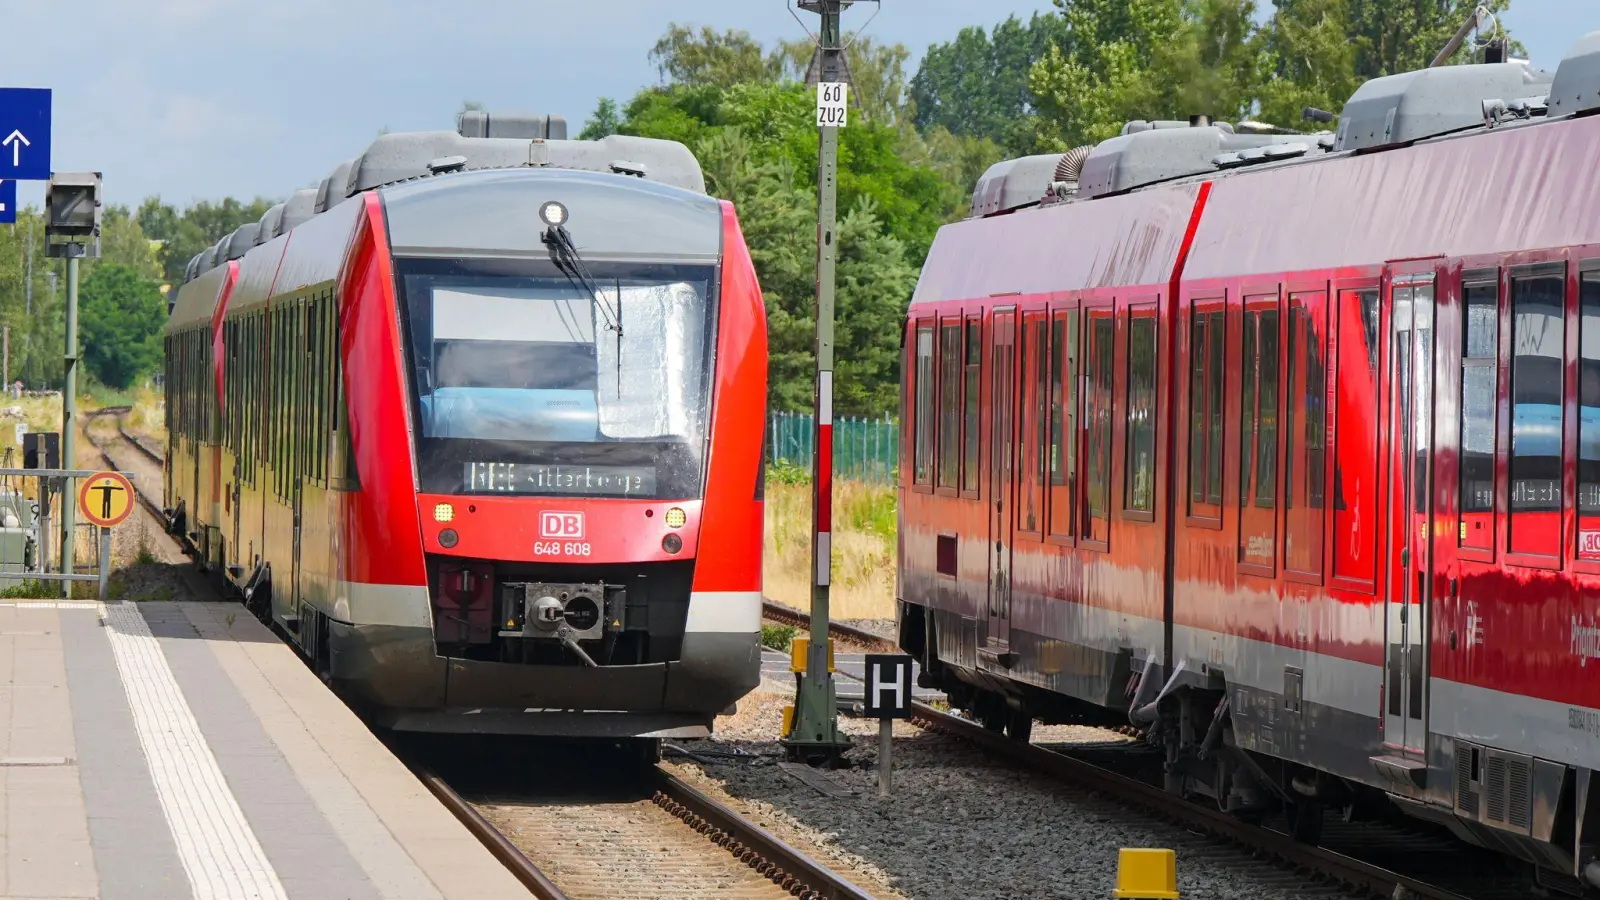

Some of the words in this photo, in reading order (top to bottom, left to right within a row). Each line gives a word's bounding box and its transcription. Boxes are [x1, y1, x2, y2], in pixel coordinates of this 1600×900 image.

[823, 86, 841, 102] 60
[819, 107, 845, 123] ZU2
[545, 514, 580, 535] DB
[533, 542, 560, 556] 648
[564, 542, 591, 556] 608
[872, 664, 904, 709] H
